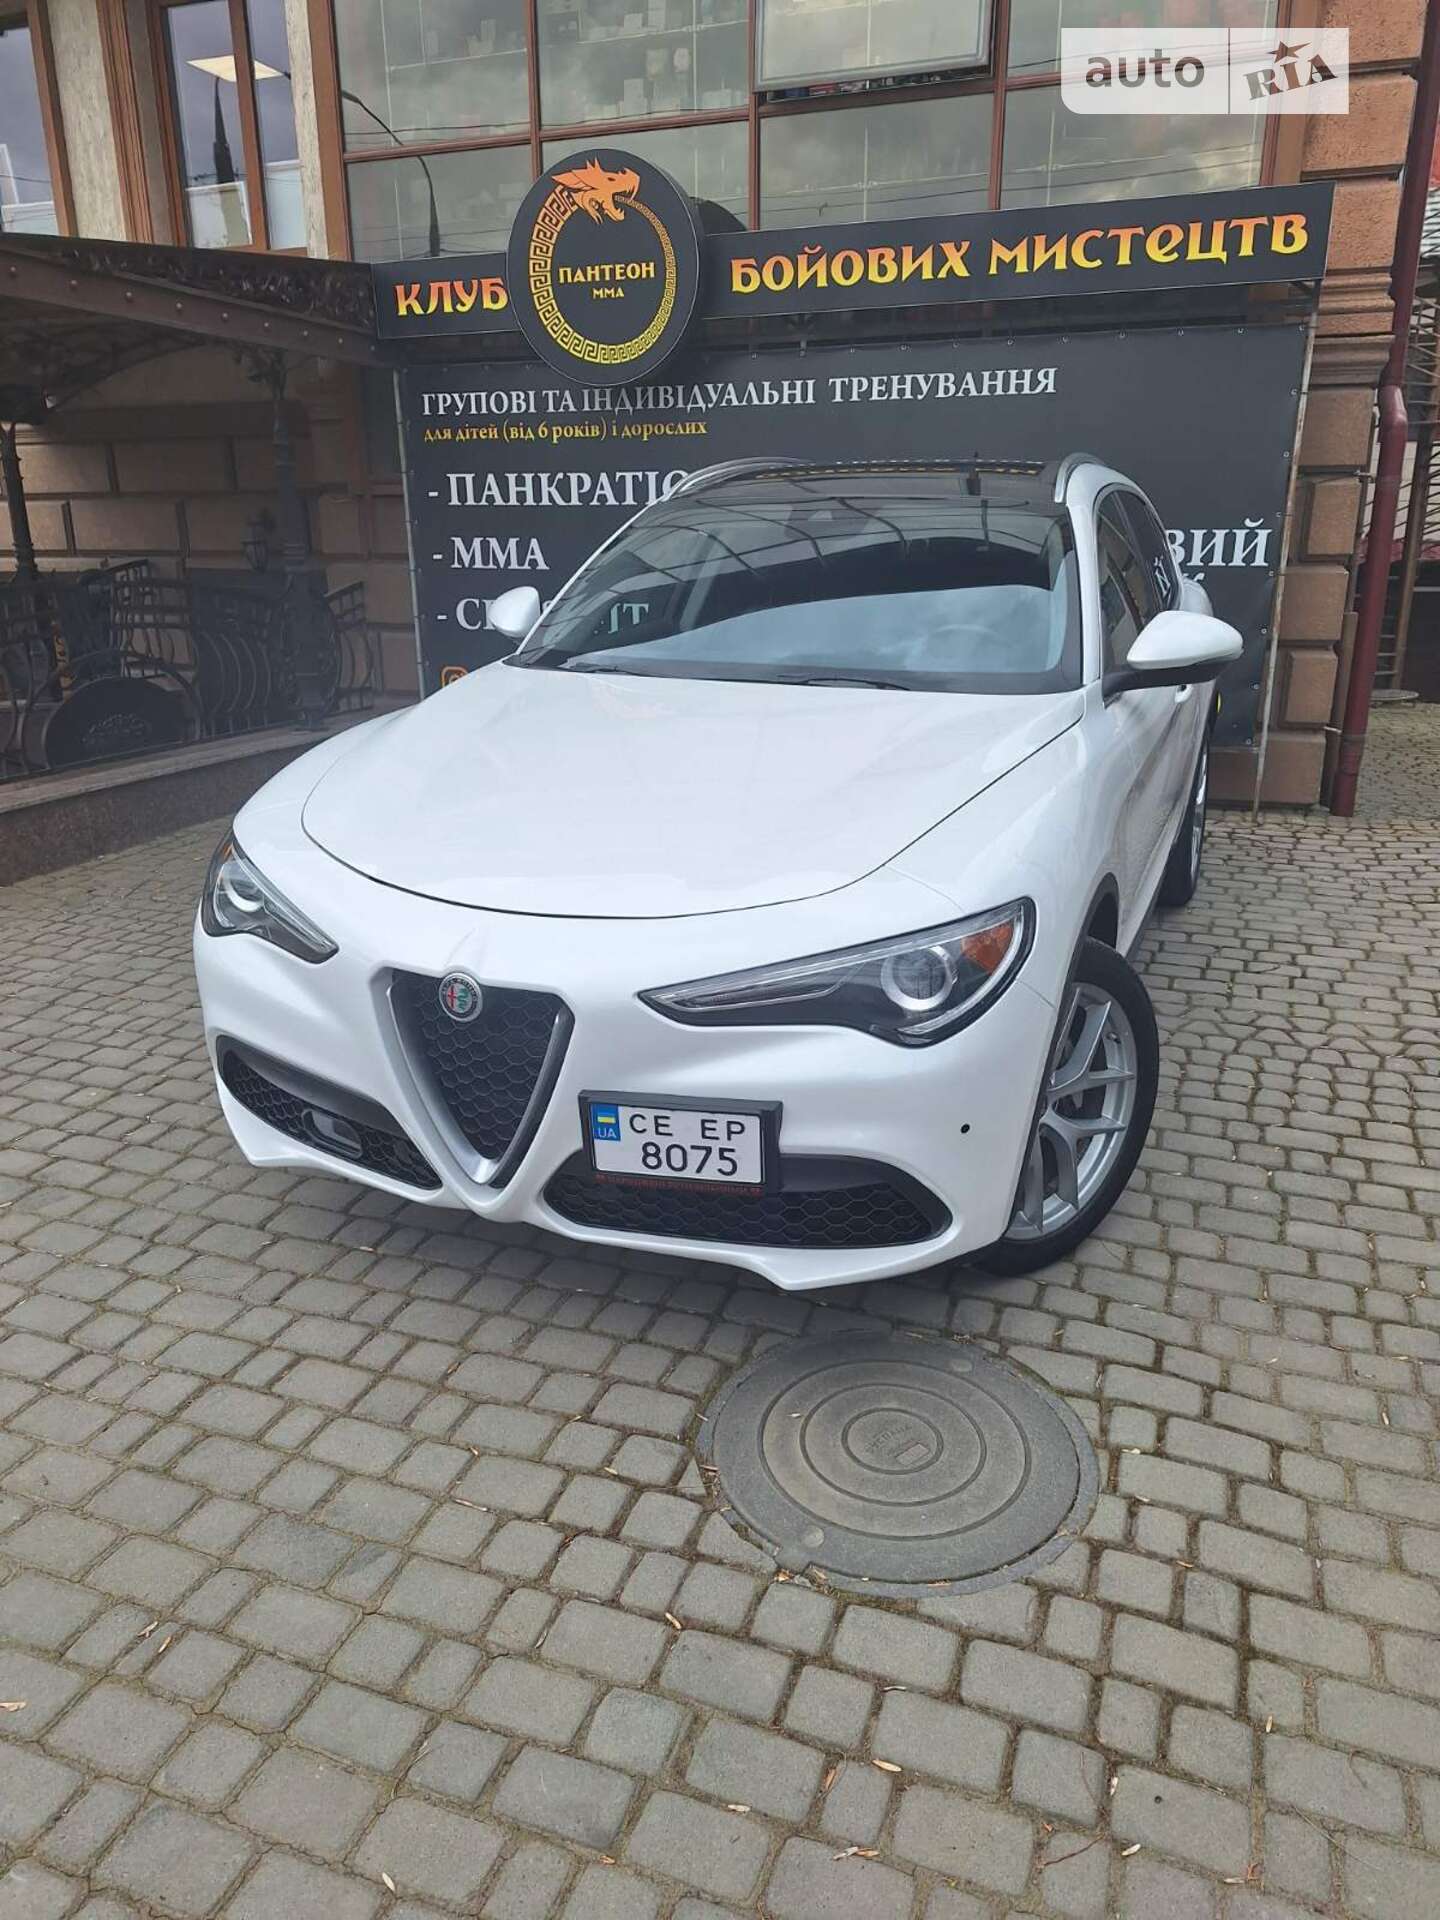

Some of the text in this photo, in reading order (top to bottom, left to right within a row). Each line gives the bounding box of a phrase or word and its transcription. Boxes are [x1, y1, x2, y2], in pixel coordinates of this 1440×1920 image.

[394, 213, 1309, 316] КЛУБ БОЙОВИХ МИСТЕЦТВ
[558, 262, 656, 283] ПАНТЕОН
[593, 287, 625, 299] ММА
[422, 367, 1058, 416] ГРУПОВІ ТА ІНДИВІДУАЛЬНІ ТРЕНУВАННЯ
[424, 416, 708, 444] для дітей (від 6 років) і дорослих
[450, 536, 550, 570] ММА
[597, 1127, 617, 1139] UA
[628, 1113, 746, 1141] CE EP
[641, 1141, 738, 1176] 8075
